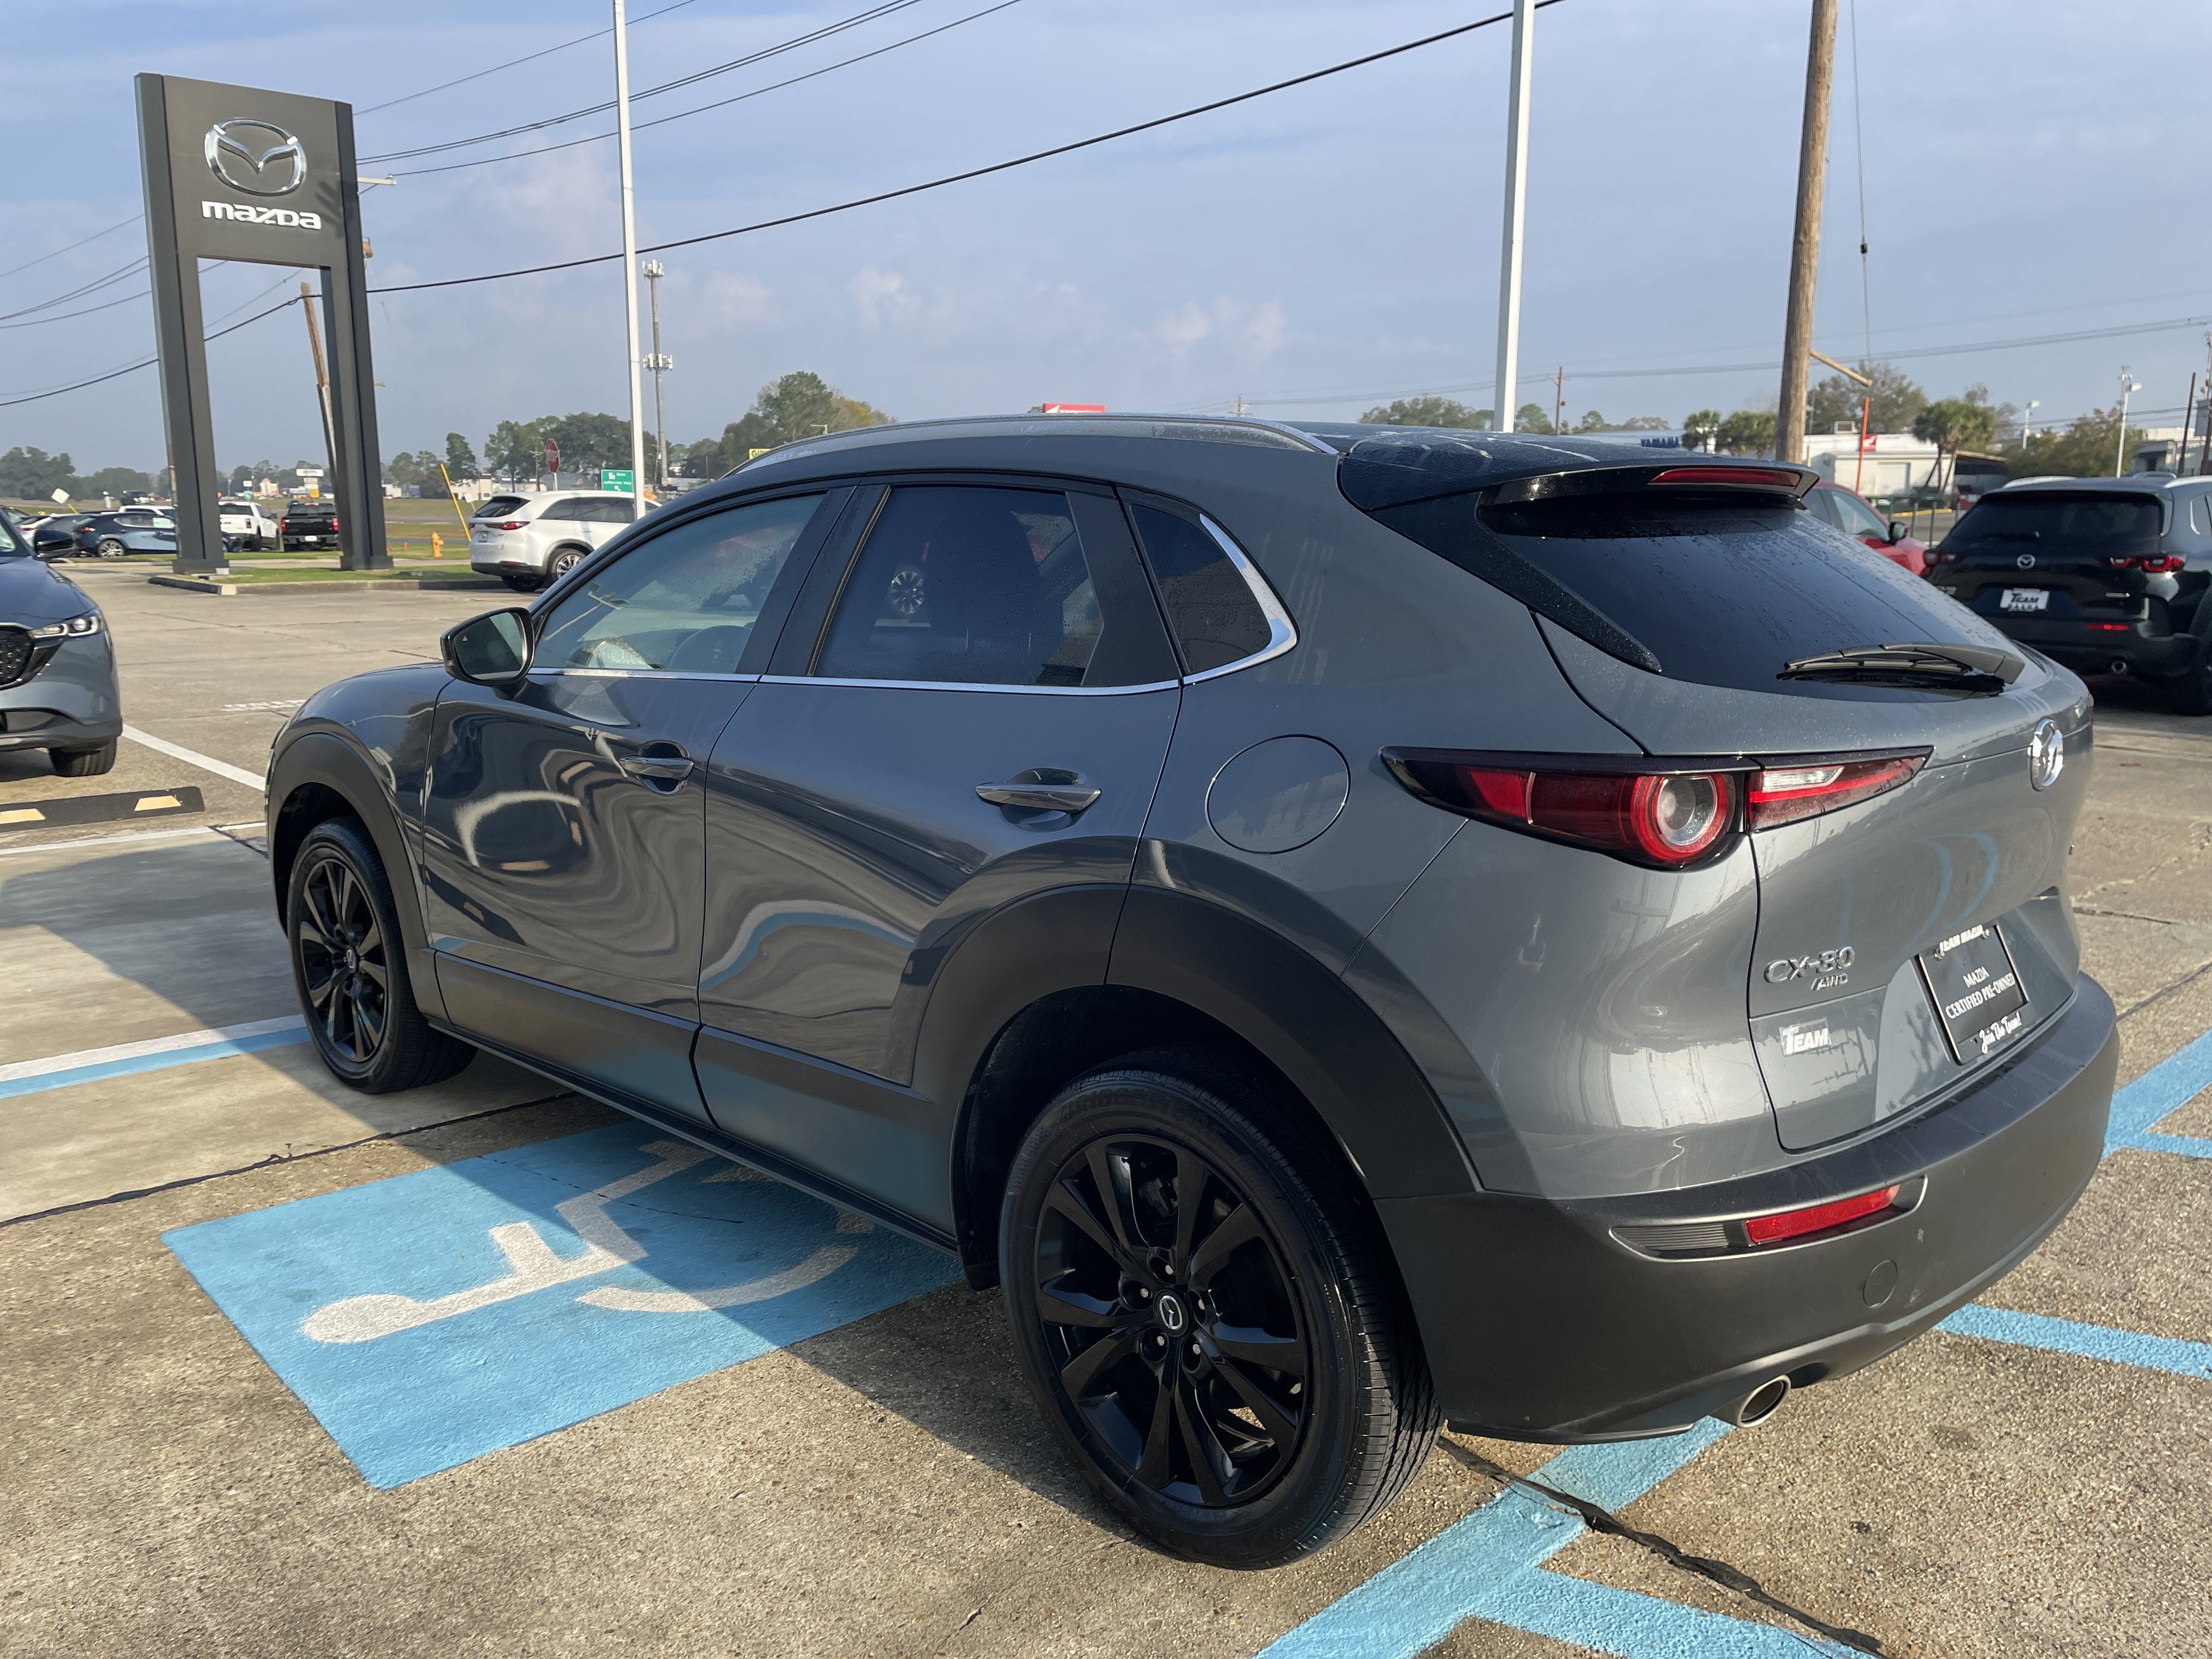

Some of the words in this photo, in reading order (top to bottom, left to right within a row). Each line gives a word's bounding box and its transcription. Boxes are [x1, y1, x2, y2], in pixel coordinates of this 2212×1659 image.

[1764, 946, 1855, 983] CX-30
[1963, 966, 1990, 988] MAZDA
[1945, 991, 1984, 1019] CERTIFIED
[1980, 972, 2016, 1001] PRE-OWNED
[1979, 1029, 1996, 1054] Join
